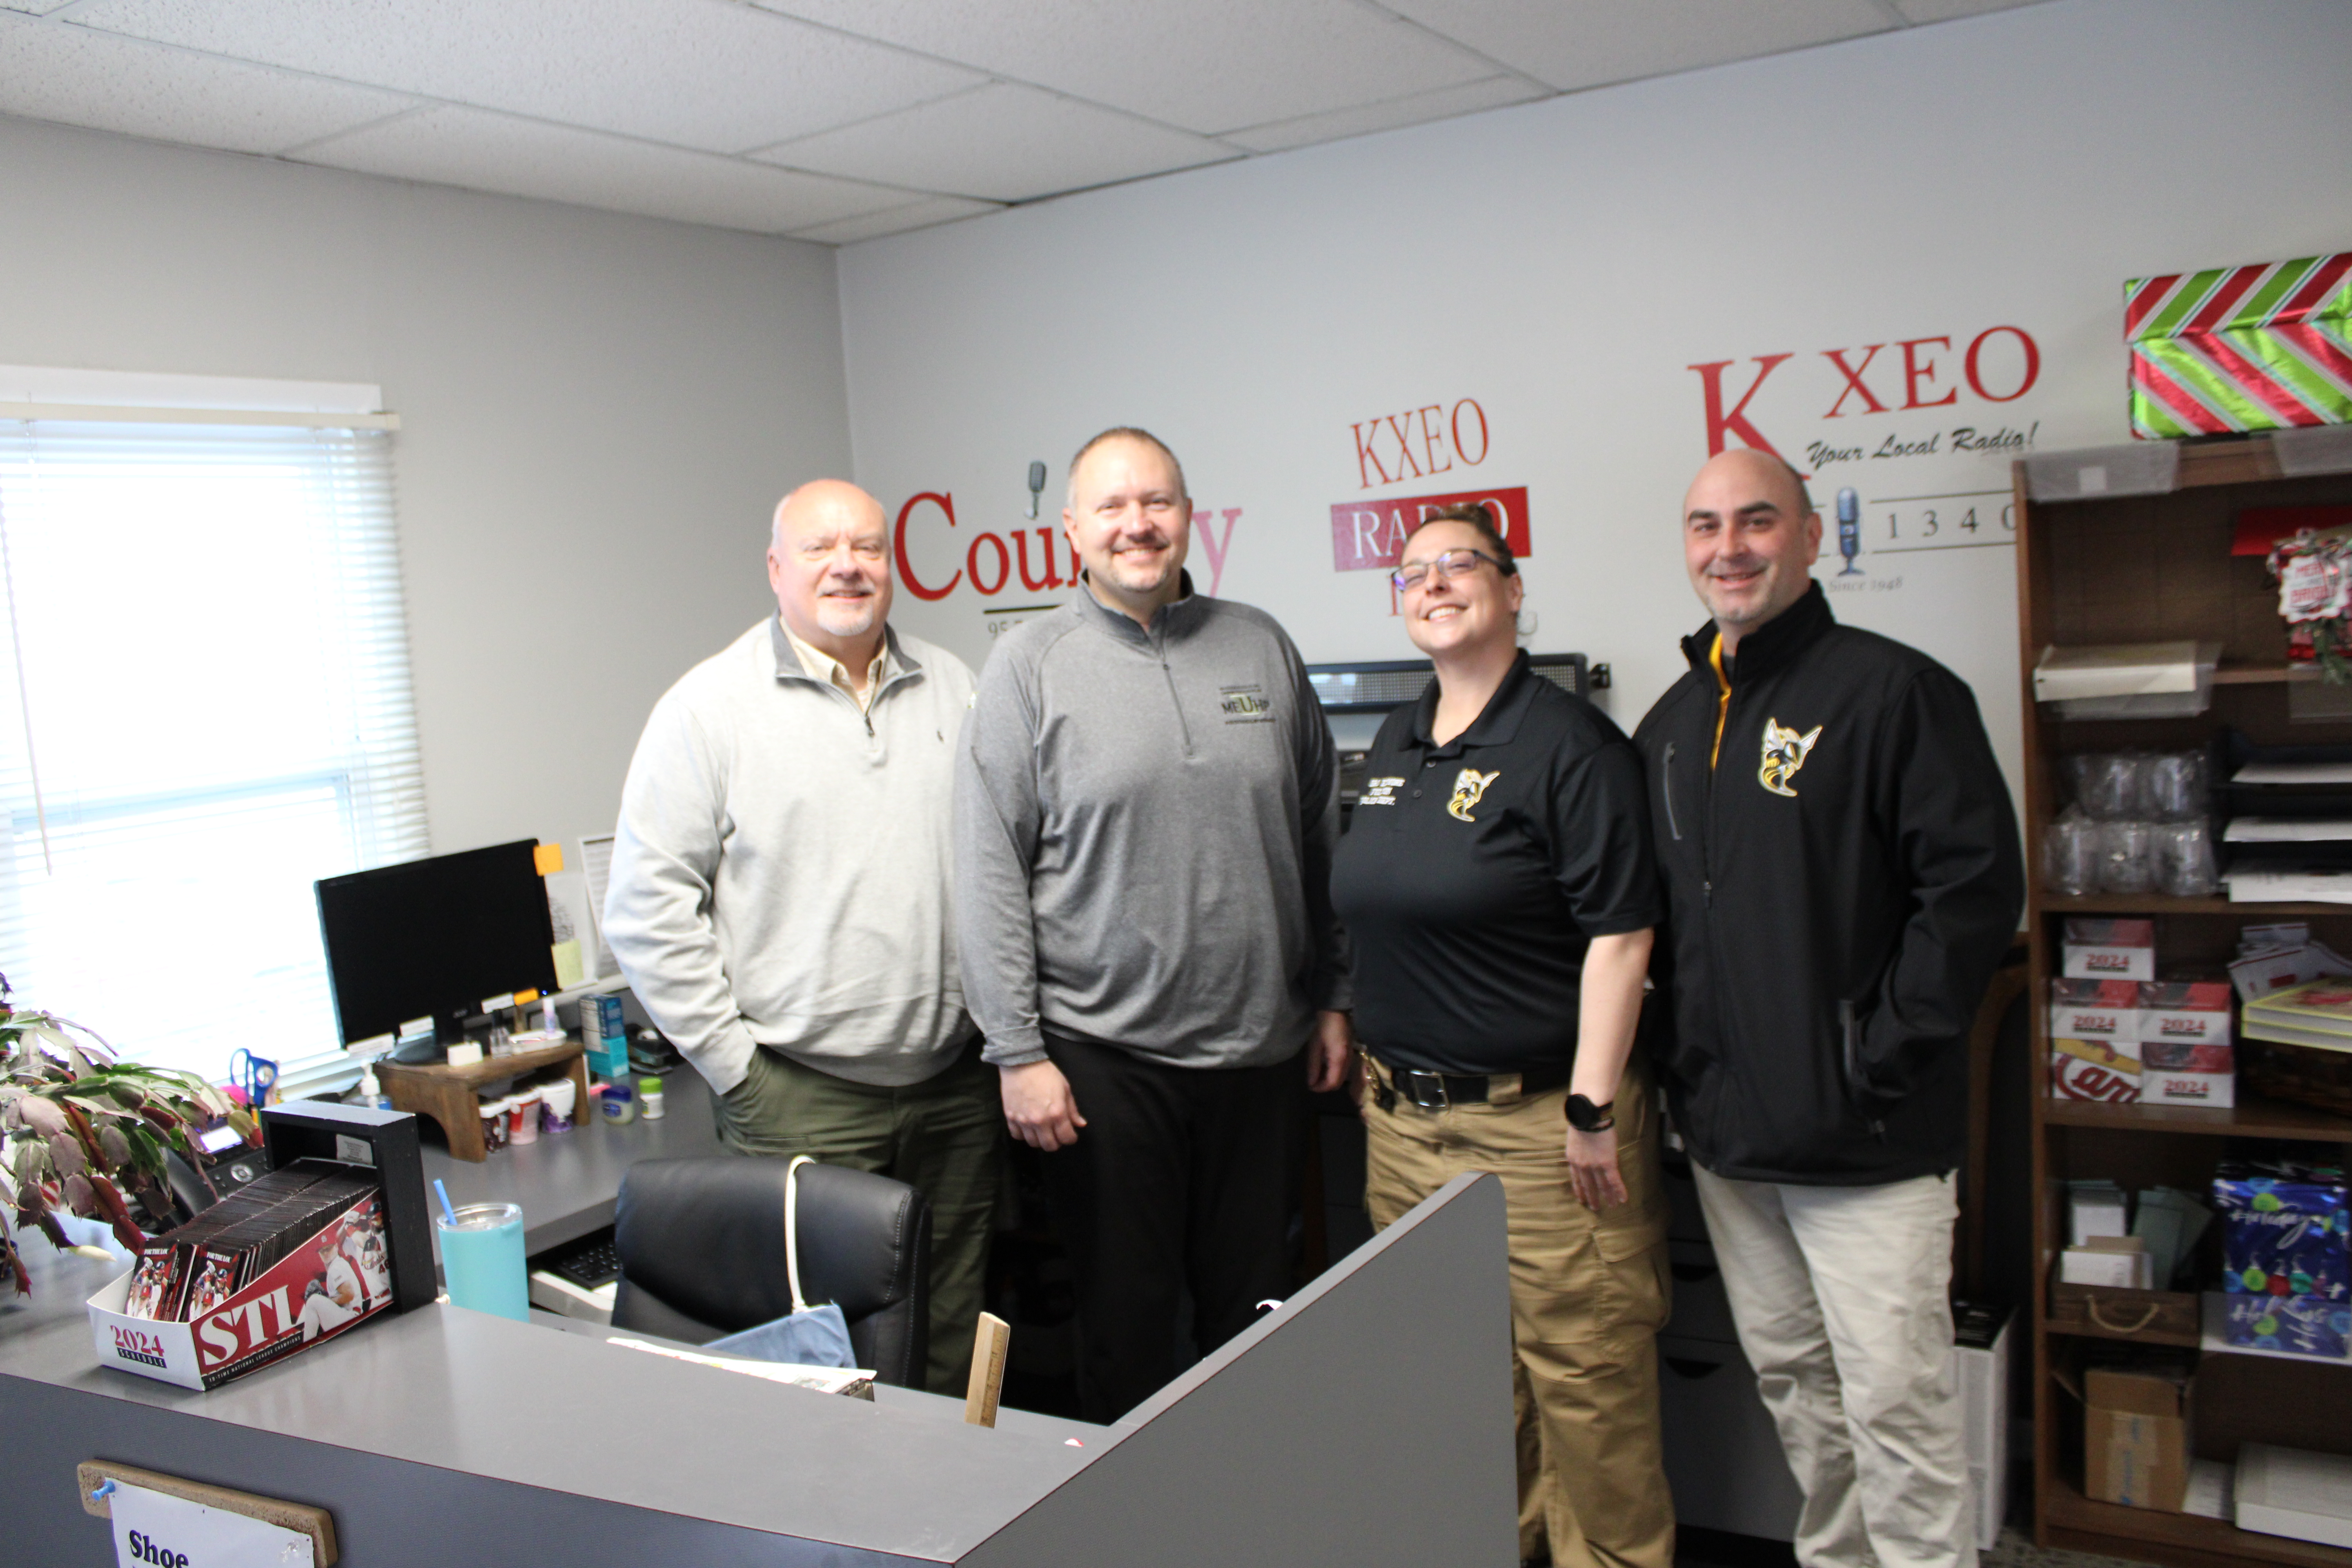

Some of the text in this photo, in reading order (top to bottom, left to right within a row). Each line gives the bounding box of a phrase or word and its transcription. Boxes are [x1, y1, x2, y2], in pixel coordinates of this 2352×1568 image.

[1350, 398, 1489, 490] KXEO
[1806, 420, 2040, 471] Your Local Radio!
[894, 491, 1242, 602] Couy
[1829, 580, 1866, 593] Since
[2086, 954, 2130, 967] 2024
[2074, 1015, 2116, 1028] 2024
[2161, 1018, 2206, 1031] 2024
[2164, 1080, 2209, 1093] 2024
[110, 1325, 165, 1357] 2024
[199, 1285, 305, 1366] STL
[119, 1349, 164, 1367] SCHEDULE
[231, 1359, 255, 1372] NATIONAL
[256, 1349, 273, 1361] LEAGUE
[275, 1336, 301, 1352] CHAMPIONS
[129, 1530, 189, 1568] Shoe
